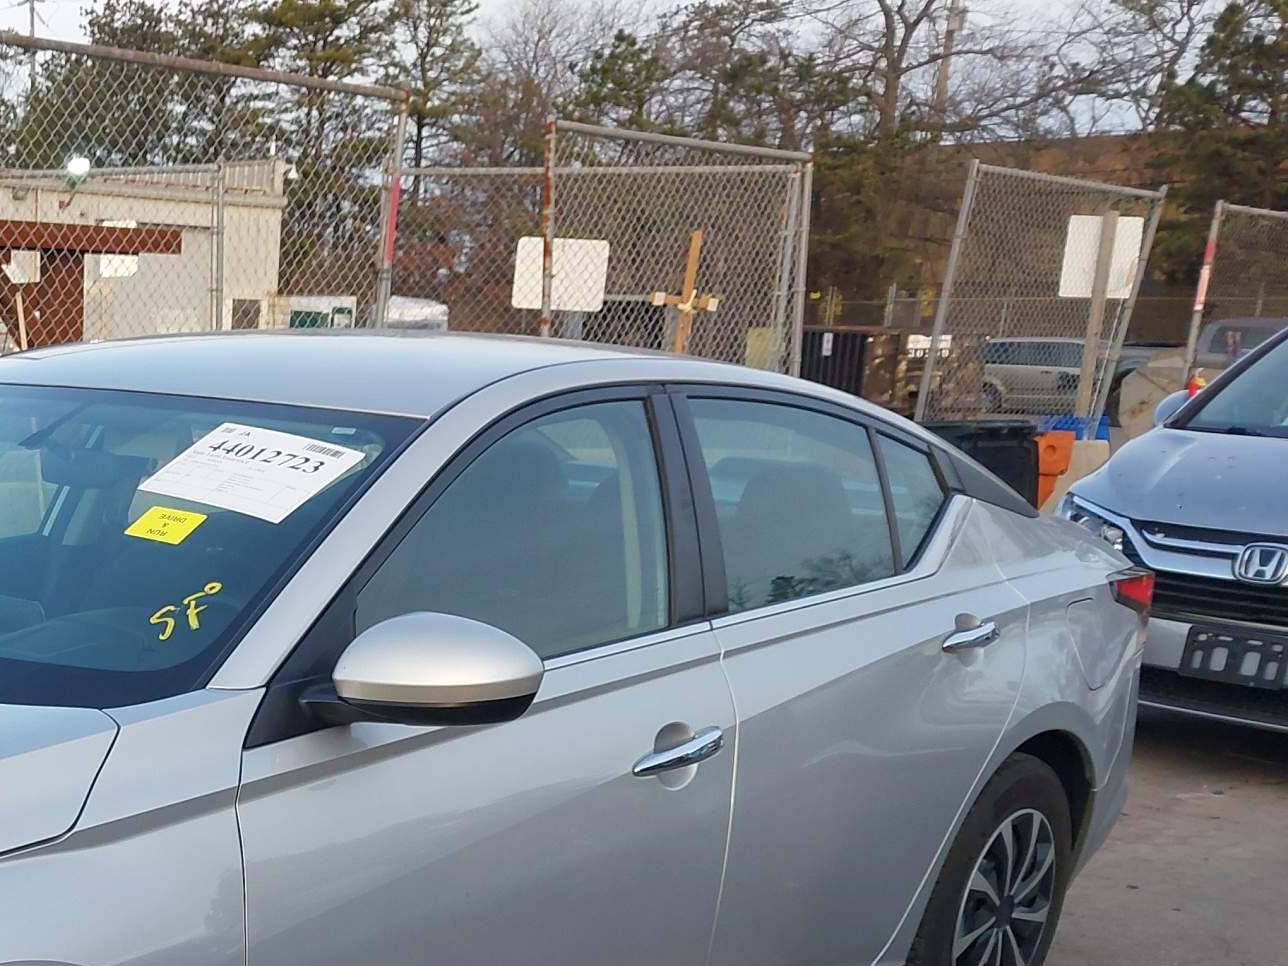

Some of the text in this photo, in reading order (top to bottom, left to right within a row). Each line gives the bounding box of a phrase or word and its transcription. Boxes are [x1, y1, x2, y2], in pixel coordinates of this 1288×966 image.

[208, 438, 326, 475] 44012723
[159, 513, 188, 524] DRIVE
[146, 528, 168, 537] RUN
